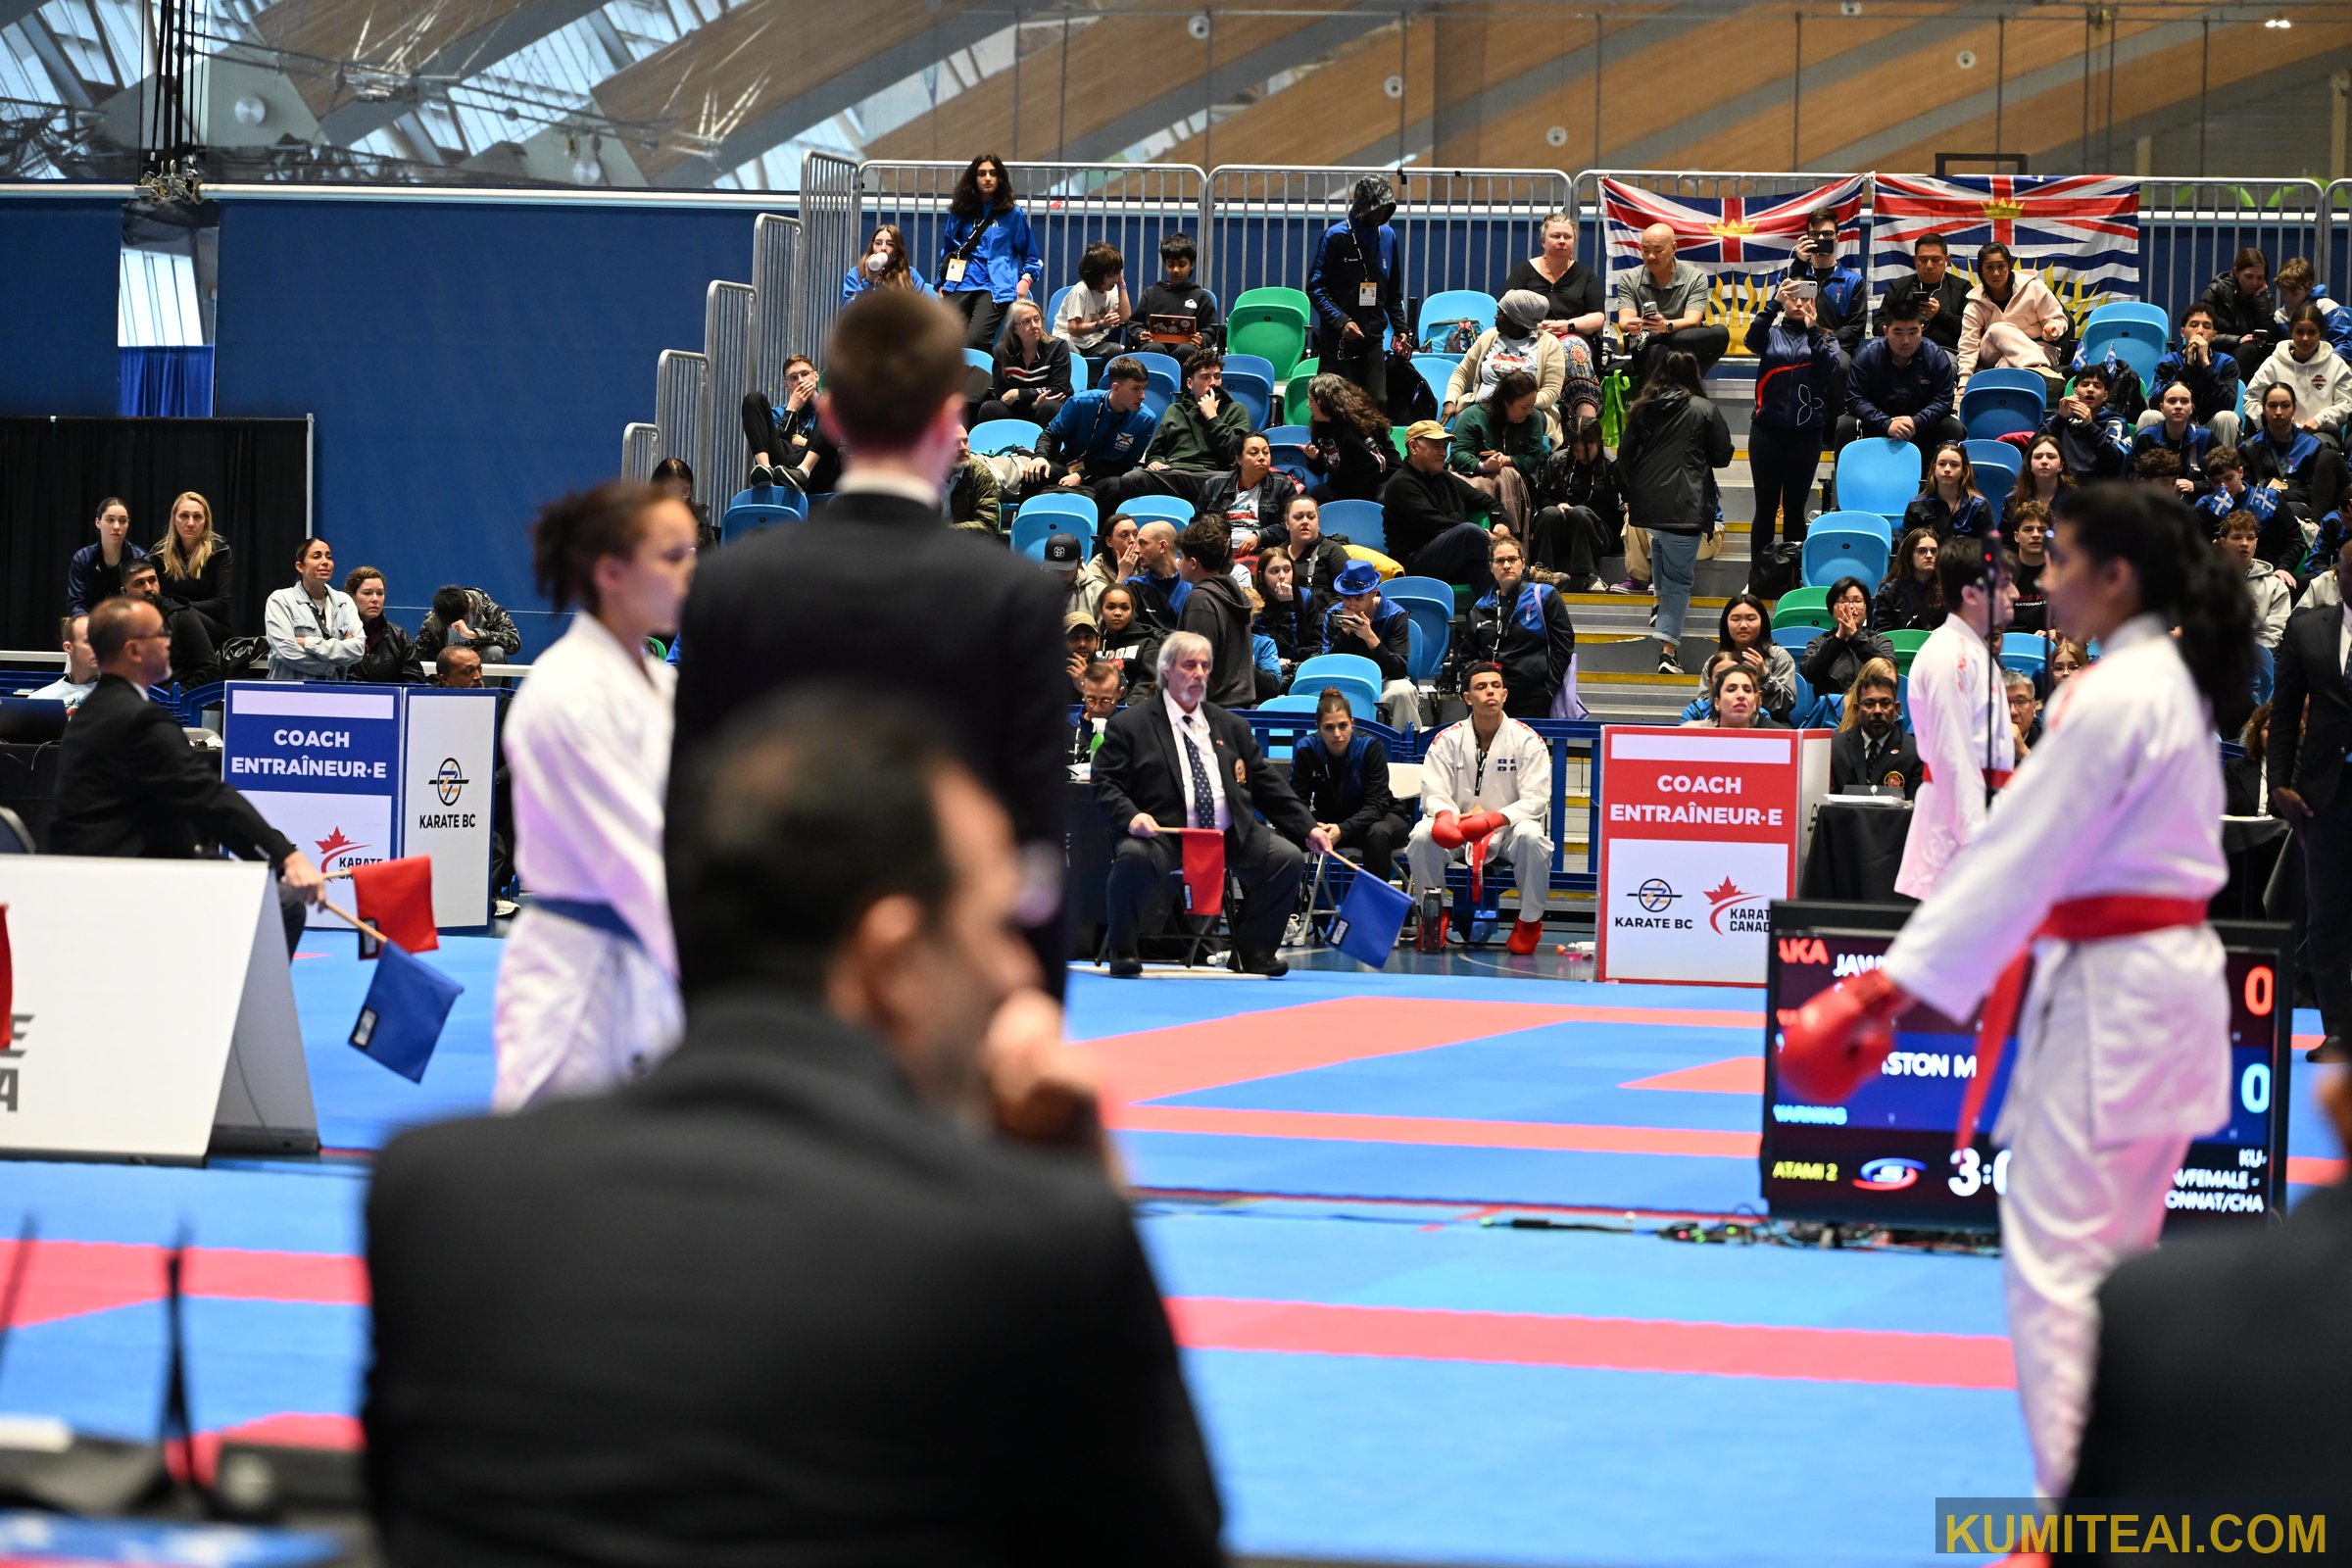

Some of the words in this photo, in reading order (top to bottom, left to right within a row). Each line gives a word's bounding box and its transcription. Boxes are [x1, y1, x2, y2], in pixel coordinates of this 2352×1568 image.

[273, 729, 350, 748] COACH
[231, 755, 387, 778] ENTRAÎNEUR·E
[1657, 775, 1741, 794] COACH
[419, 814, 460, 829] KARATE
[463, 813, 476, 828] BC
[1610, 802, 1783, 825] ENTRAÎNEUR·E
[1615, 917, 1670, 928] KARATE
[1675, 919, 1693, 929] BC
[2244, 966, 2274, 1016] 0
[2240, 1062, 2271, 1113] 0
[1826, 1163, 1838, 1182] 2
